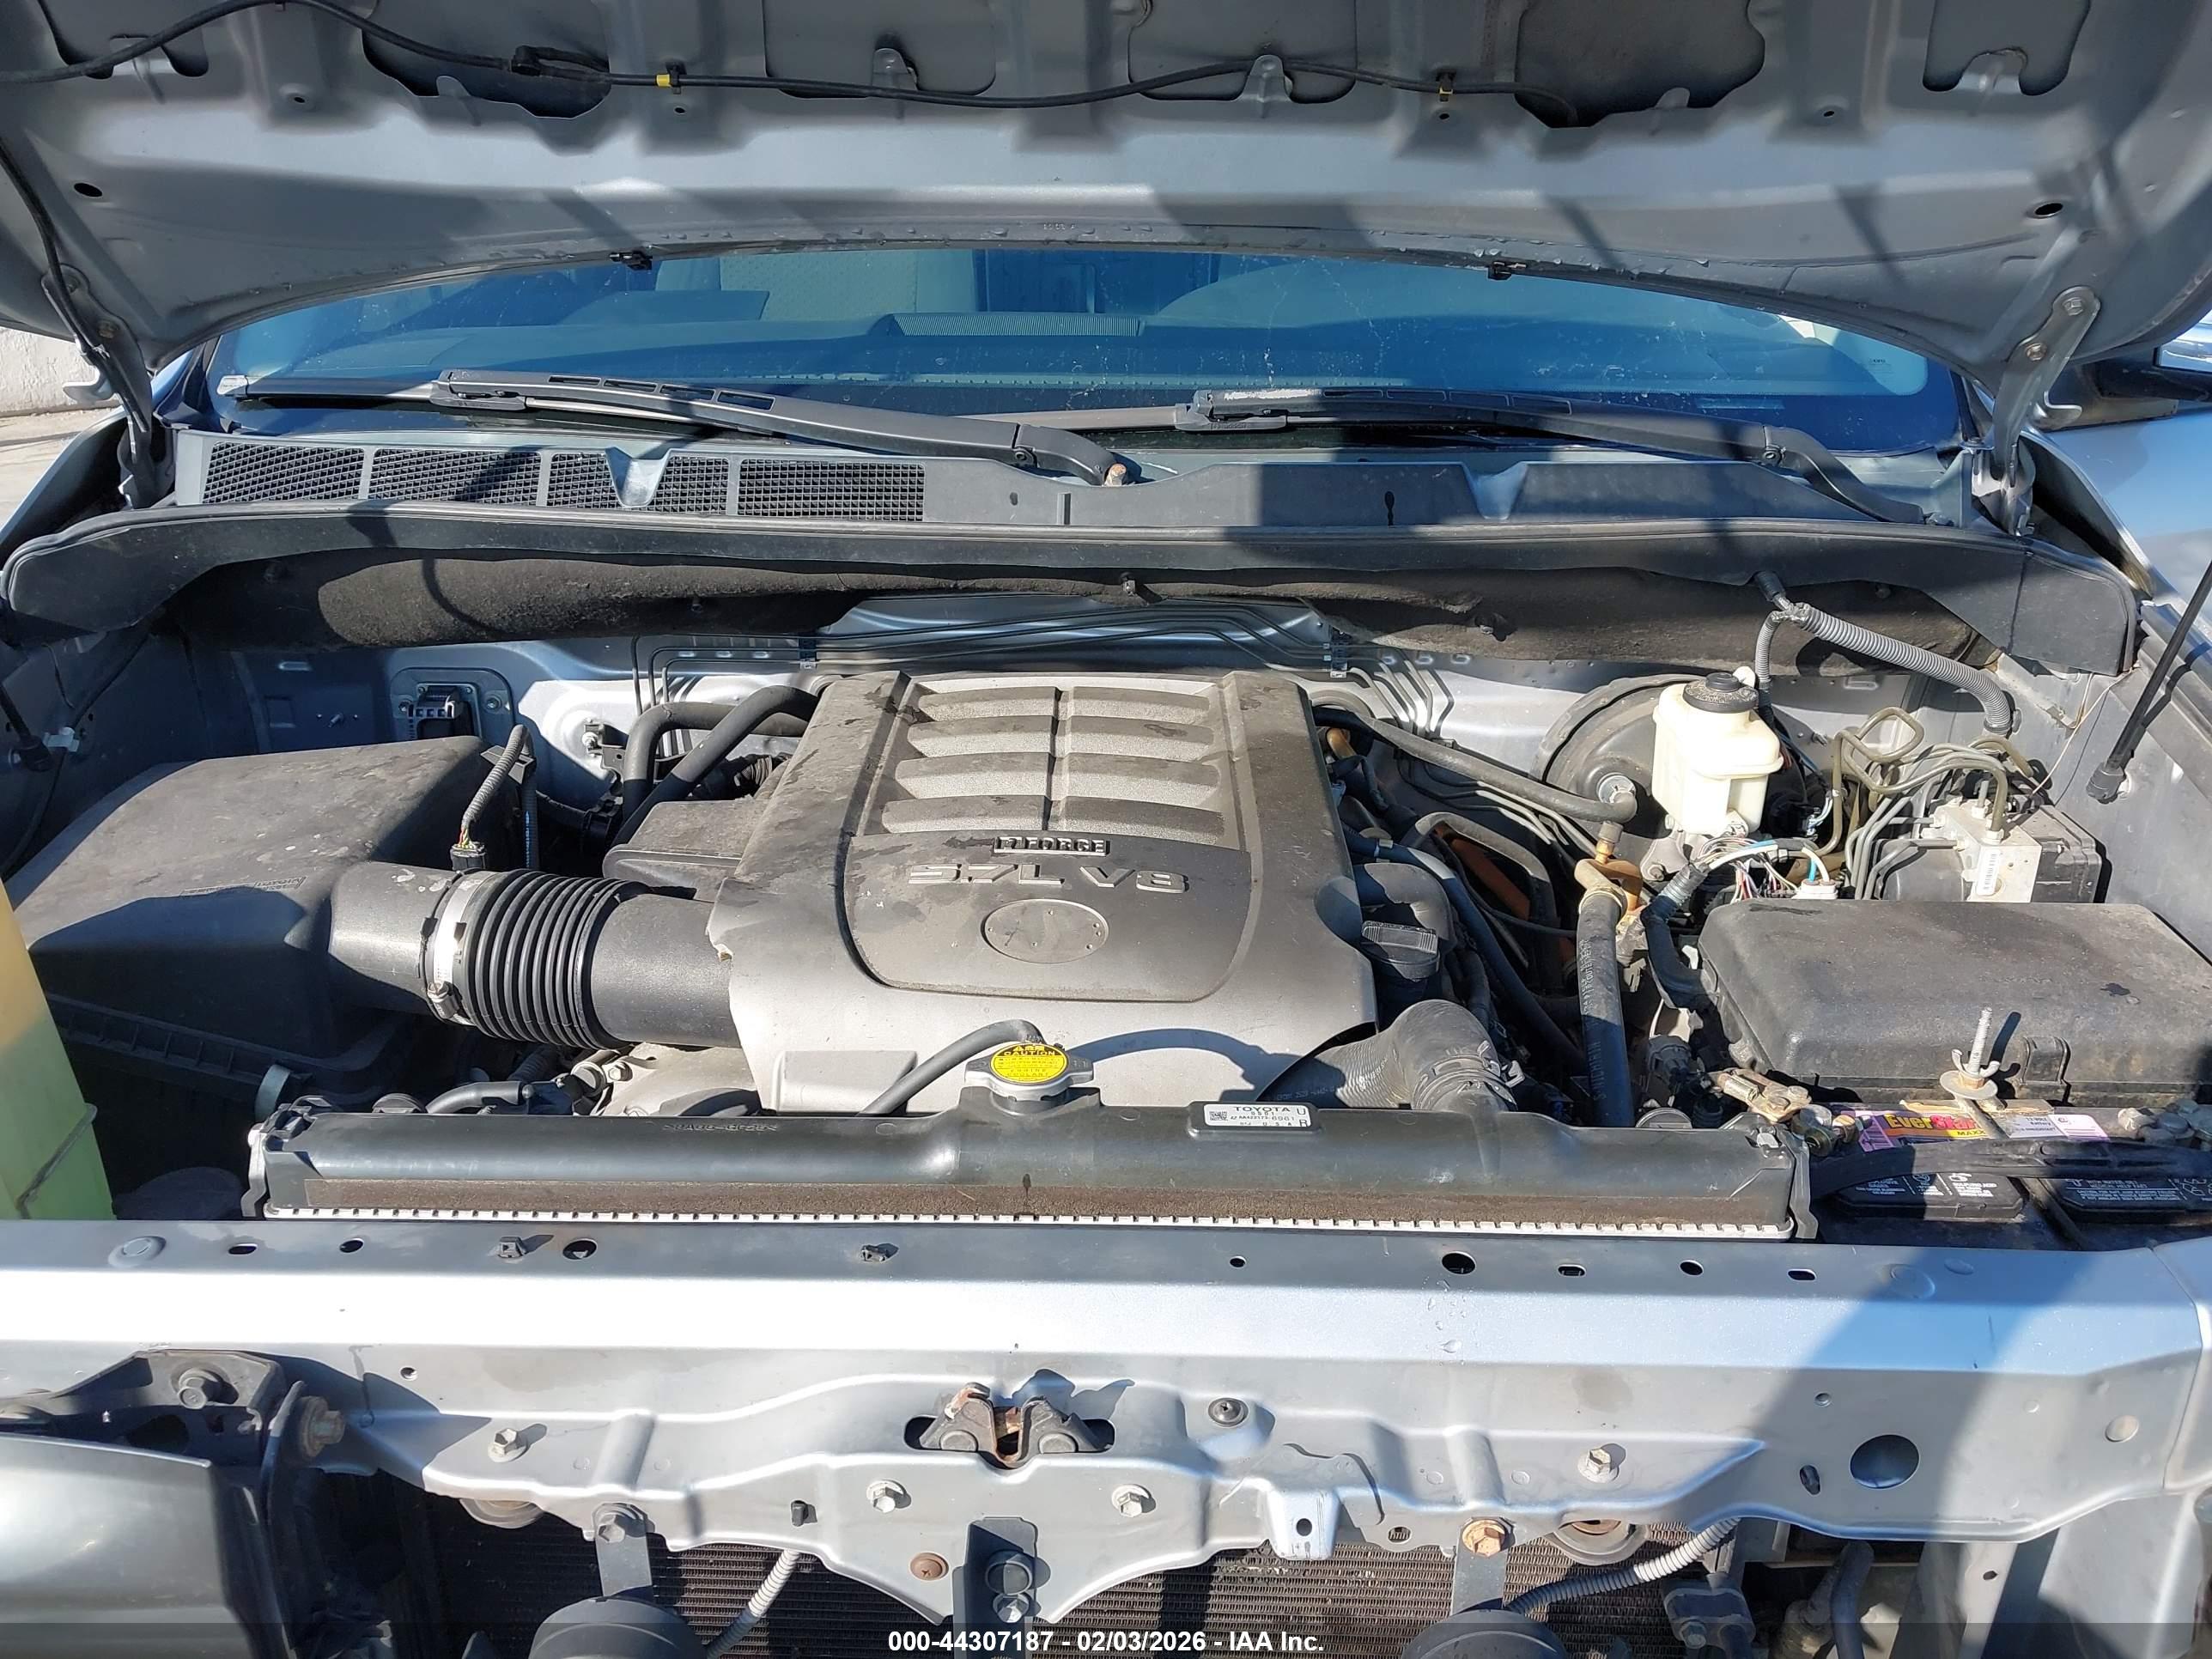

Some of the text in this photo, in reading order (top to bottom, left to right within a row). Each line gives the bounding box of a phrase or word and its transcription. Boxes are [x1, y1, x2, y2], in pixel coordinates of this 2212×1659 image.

[908, 862, 1189, 894] 5.7L V8
[1885, 1114, 1978, 1129] EverStar
